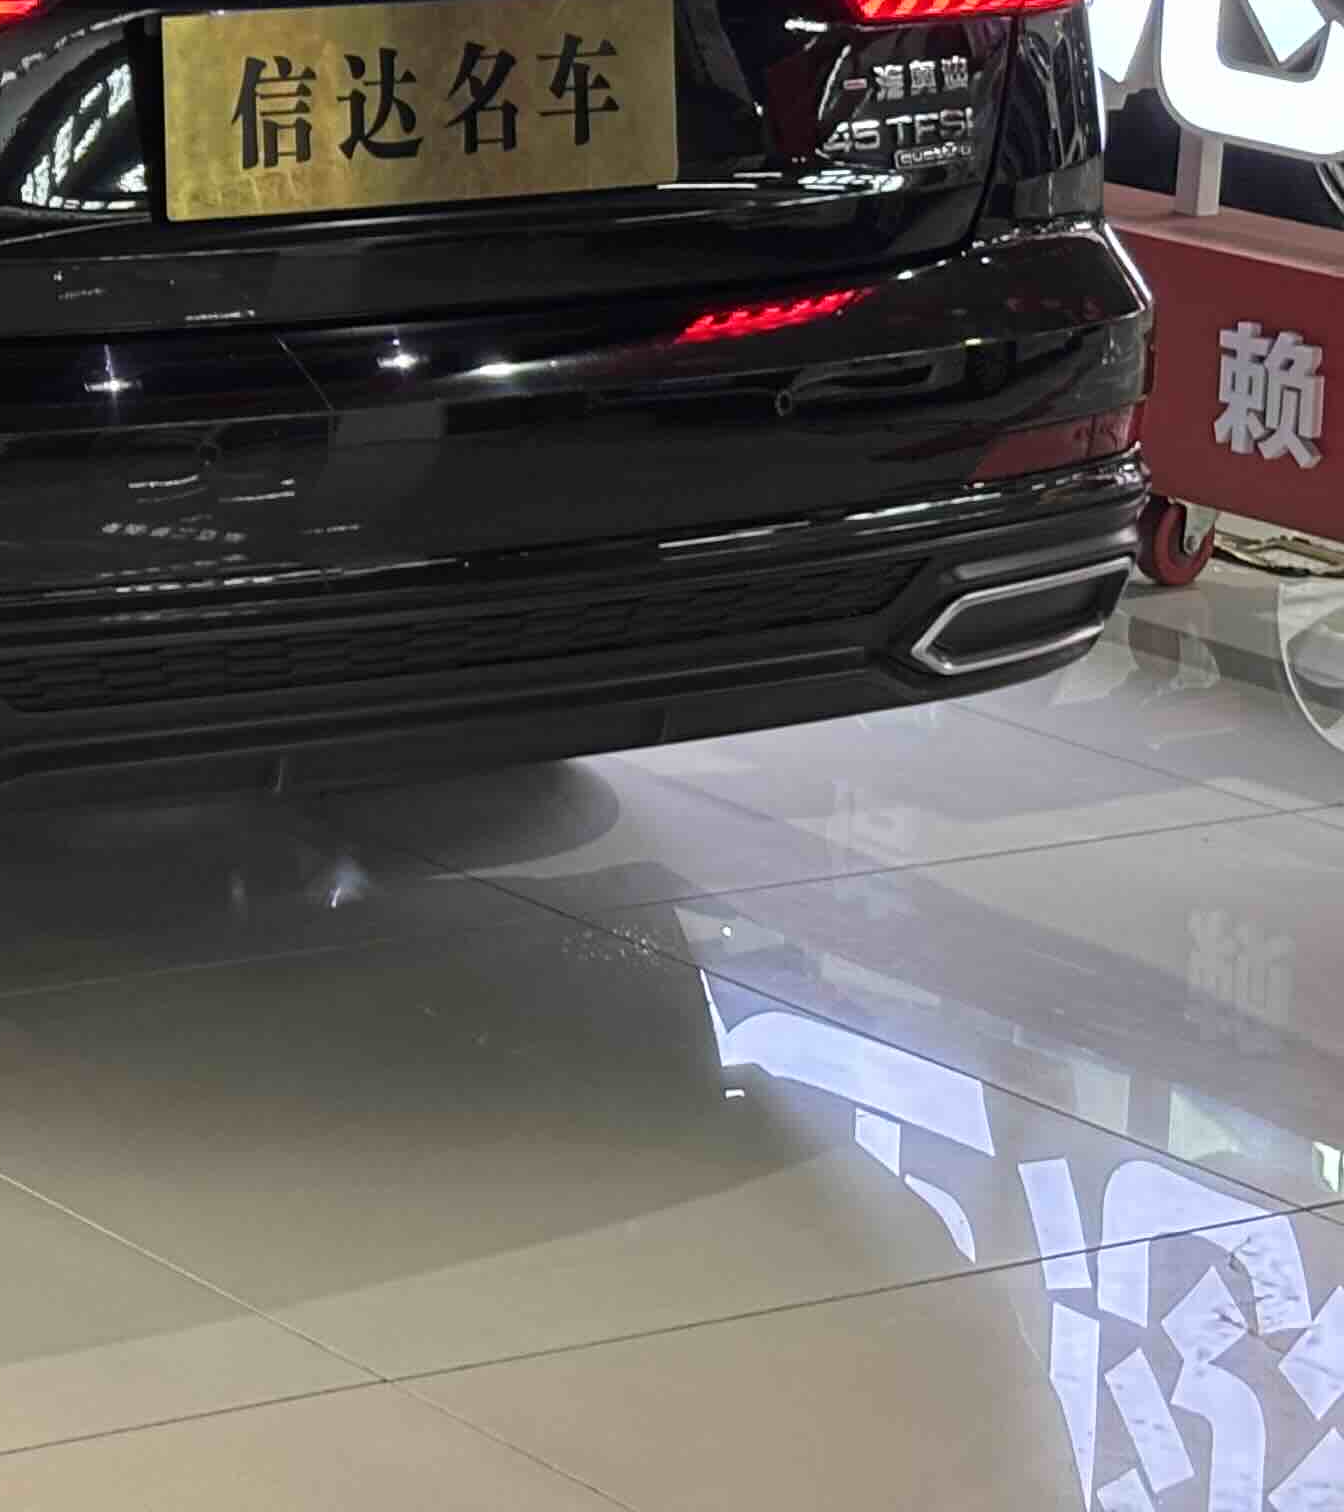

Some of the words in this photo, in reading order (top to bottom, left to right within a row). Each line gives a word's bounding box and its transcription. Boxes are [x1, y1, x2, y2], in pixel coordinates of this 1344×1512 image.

[231, 33, 620, 170] 信达名车
[822, 120, 881, 153] 45
[885, 105, 974, 146] TFSI
[1215, 319, 1323, 468] 赖
